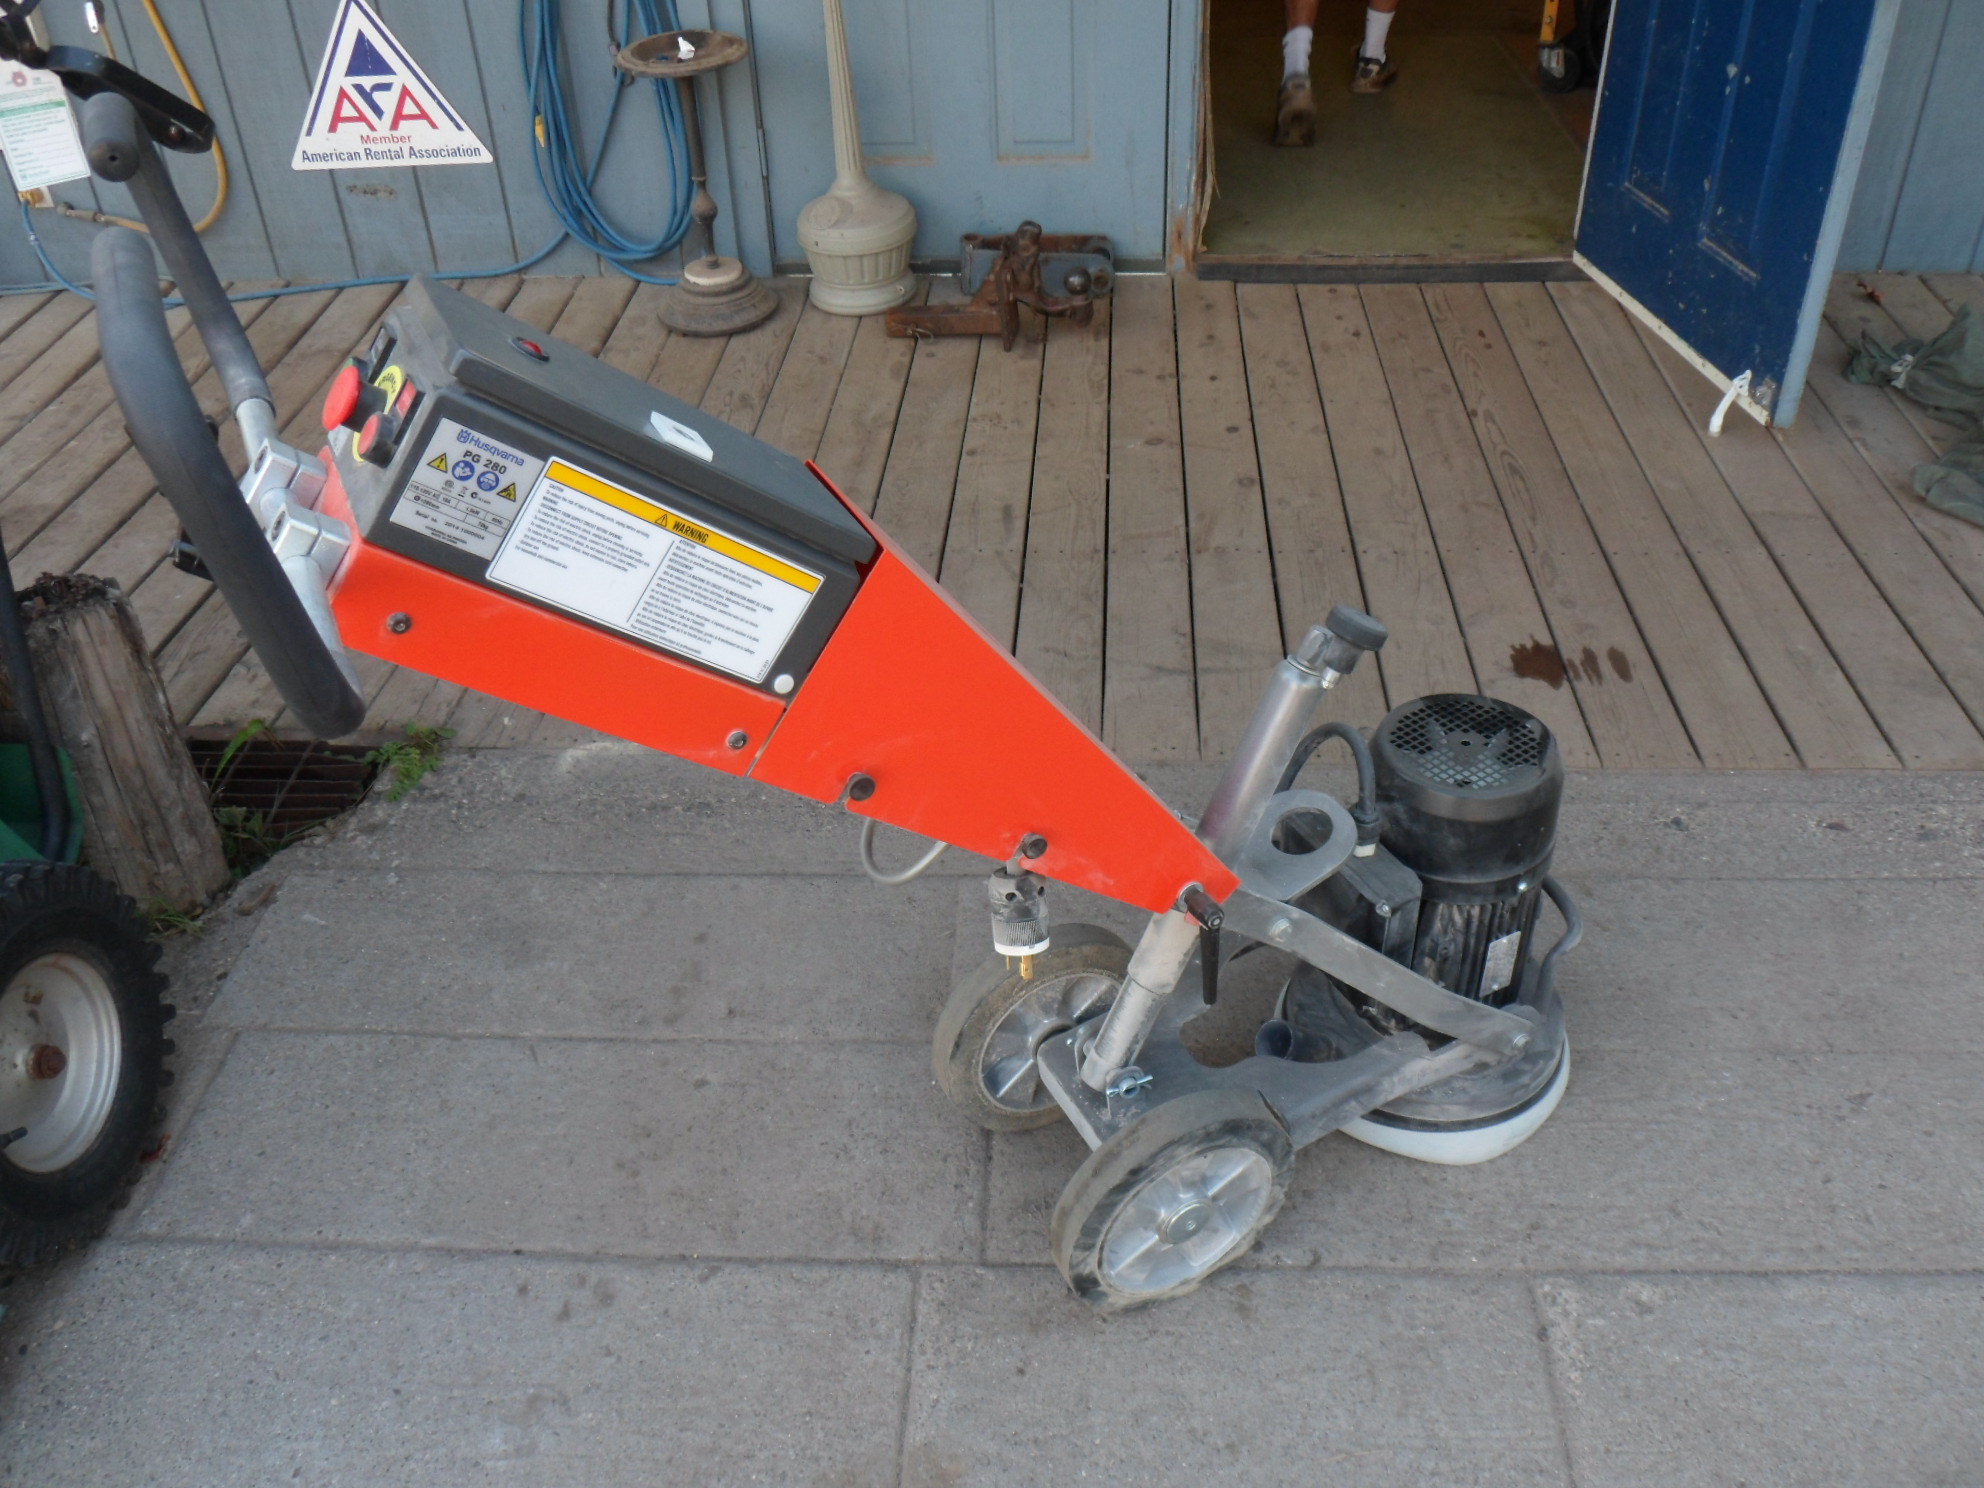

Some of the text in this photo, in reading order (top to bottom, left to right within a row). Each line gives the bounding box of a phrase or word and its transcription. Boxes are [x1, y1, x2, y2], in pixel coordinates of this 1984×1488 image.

[360, 134, 412, 145] Member
[302, 145, 481, 163] American Rental Association
[468, 436, 525, 466] Husqvarna
[463, 450, 508, 476] PG 280
[672, 520, 709, 543] WARNING
